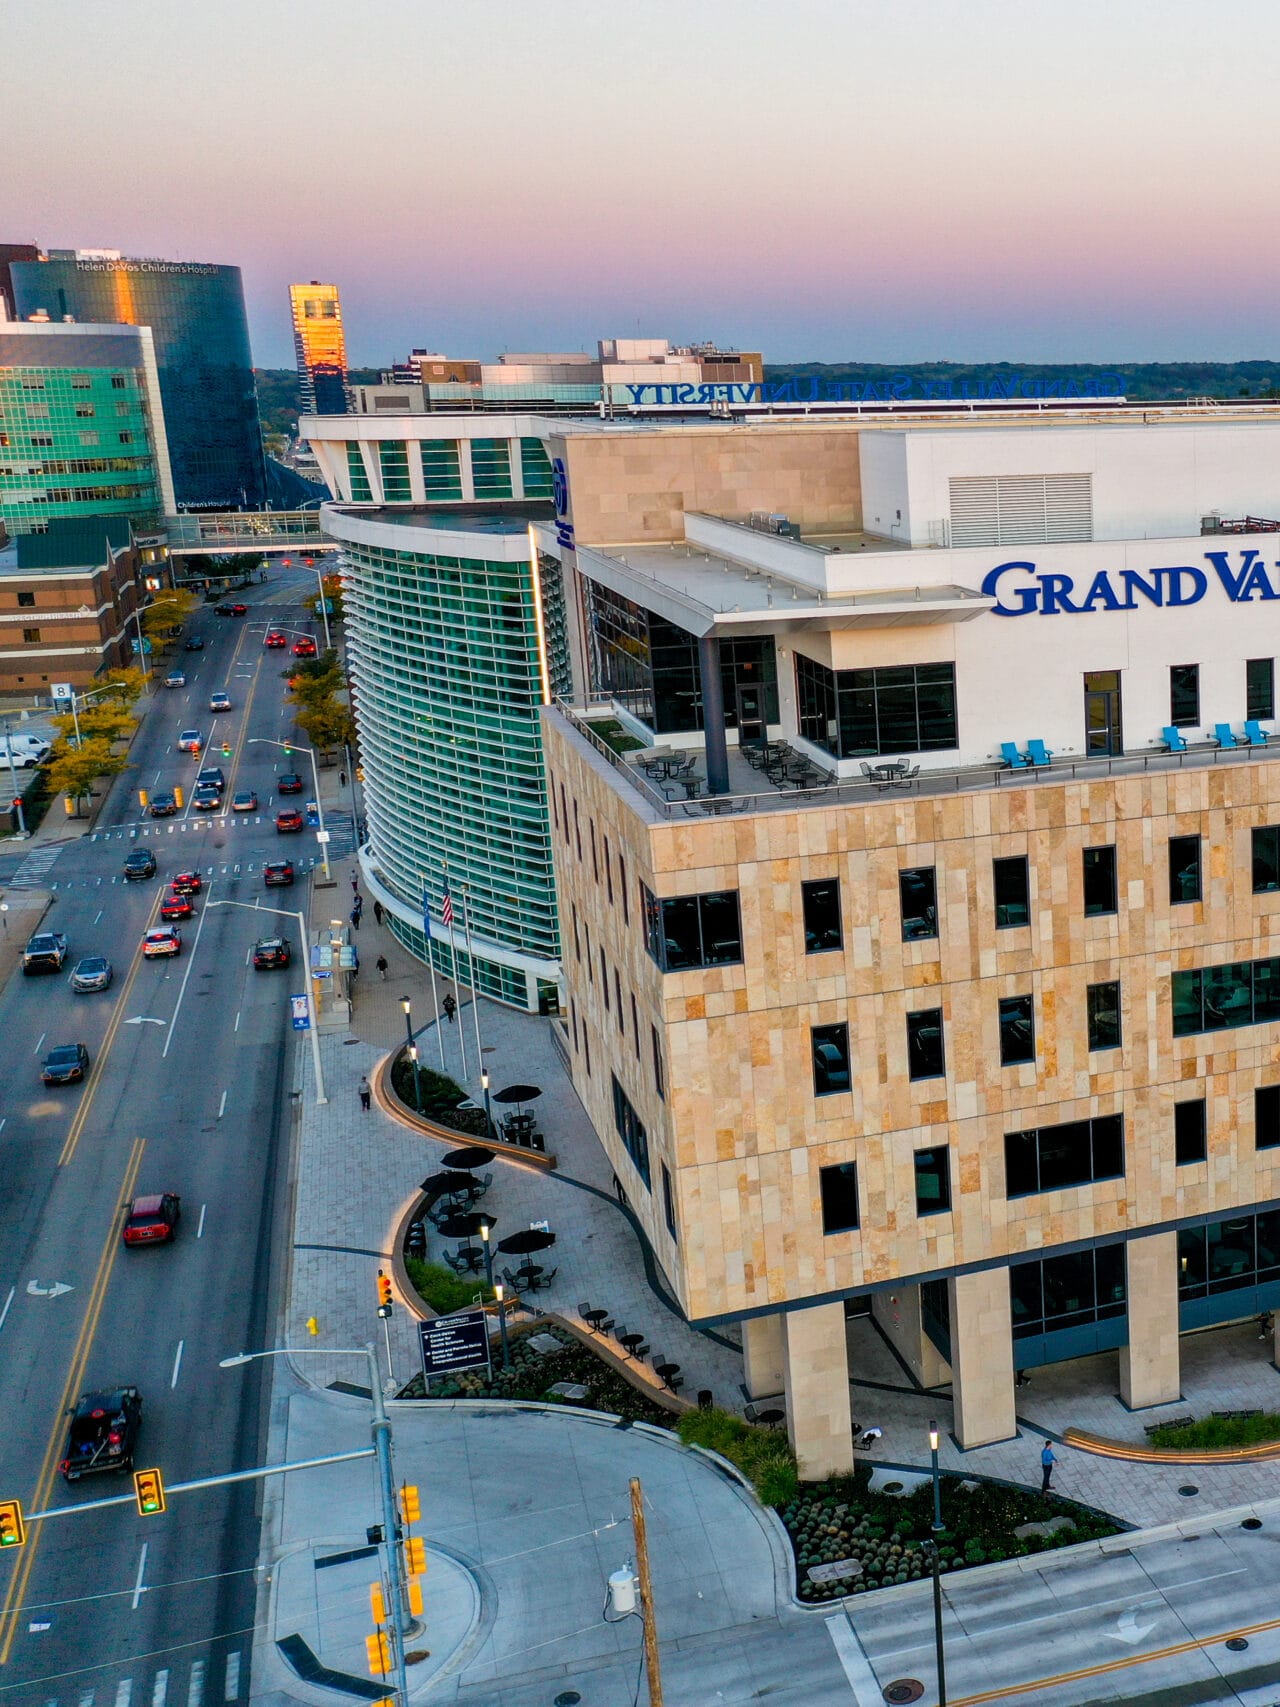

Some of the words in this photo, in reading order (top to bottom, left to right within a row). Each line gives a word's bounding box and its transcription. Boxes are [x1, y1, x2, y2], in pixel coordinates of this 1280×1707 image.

[76, 263, 105, 271] Helen
[106, 263, 140, 272] DeVos
[141, 263, 187, 274] Children's
[188, 265, 219, 275] Hospital
[981, 561, 1208, 616] GRAND
[57, 686, 65, 696] 8
